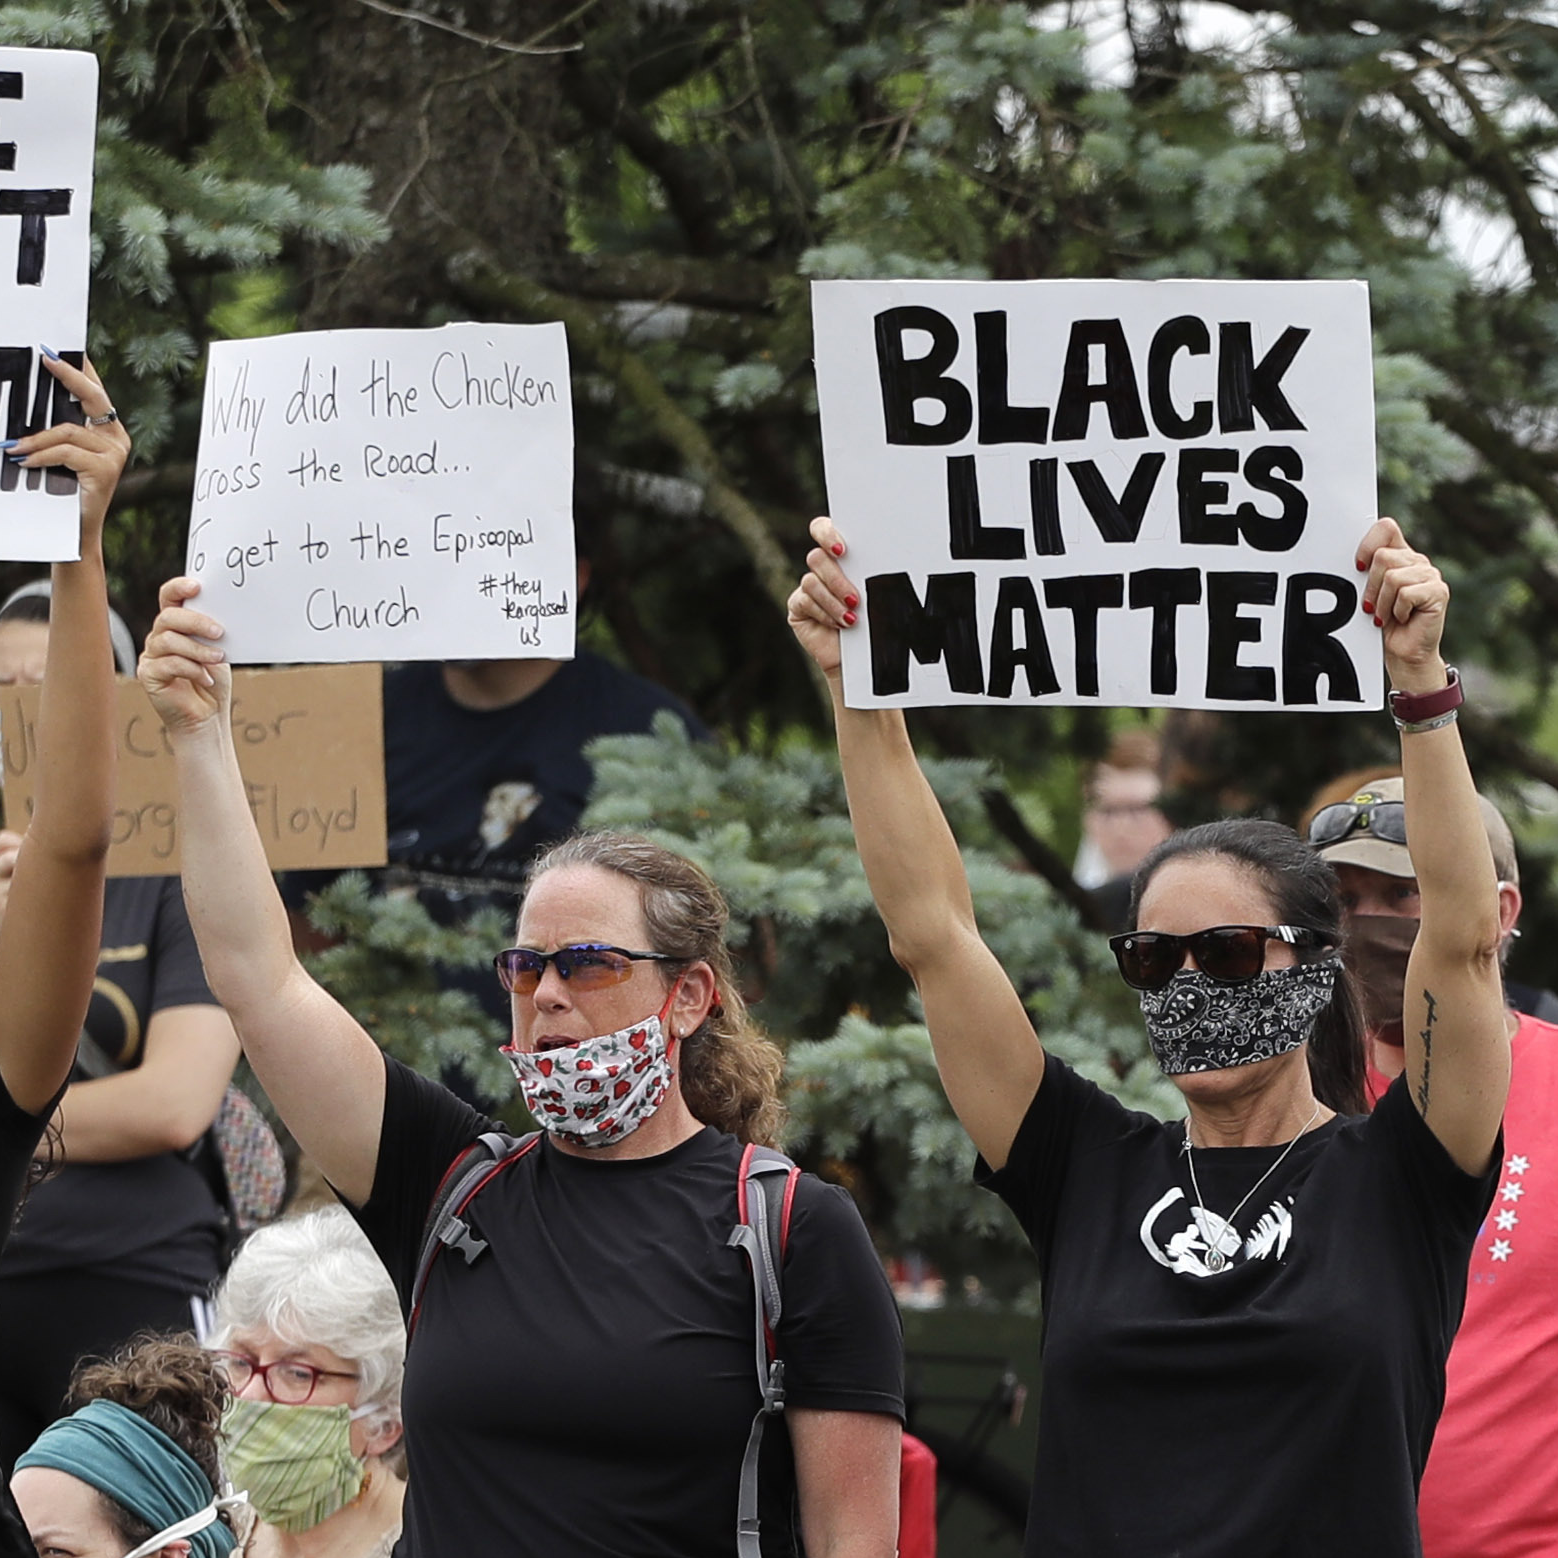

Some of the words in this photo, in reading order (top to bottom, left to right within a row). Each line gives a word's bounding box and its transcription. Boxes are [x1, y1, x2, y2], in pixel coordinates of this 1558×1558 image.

[211, 359, 266, 457] Why
[285, 356, 339, 425] did
[360, 359, 418, 417] the
[431, 341, 557, 410] Chicken
[873, 305, 1311, 445] BLACK
[195, 462, 262, 502] cross
[287, 448, 344, 488] the
[363, 440, 471, 479] Road...
[947, 445, 1309, 560] LIVES
[225, 528, 280, 588] get
[299, 522, 330, 564] to
[350, 520, 410, 561] the
[306, 585, 420, 631] Church
[519, 626, 542, 647] us
[865, 567, 1366, 706] MATTER
